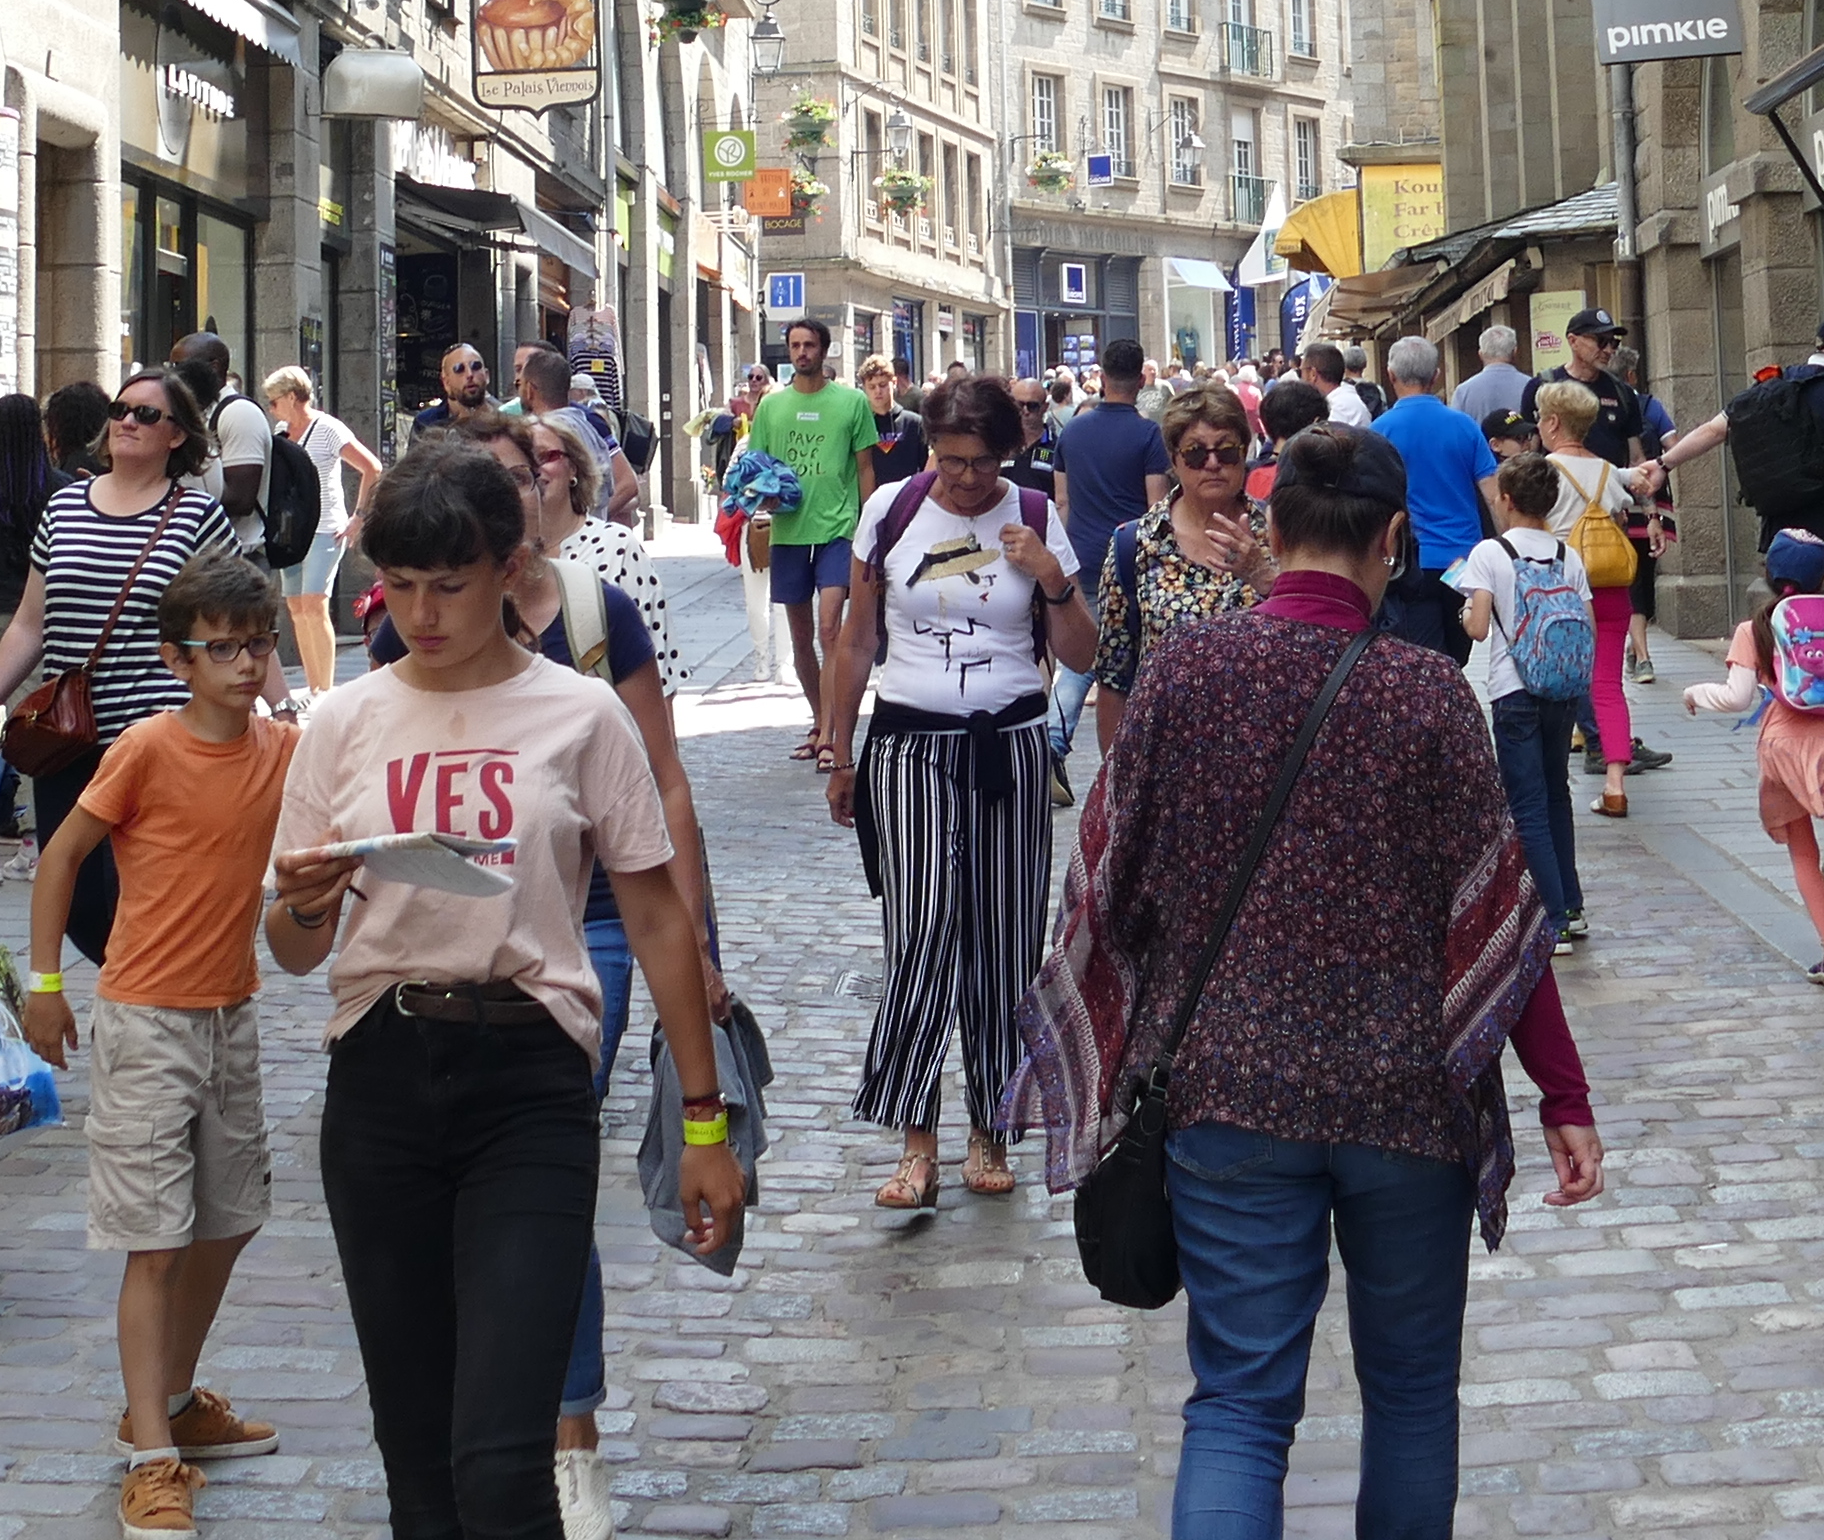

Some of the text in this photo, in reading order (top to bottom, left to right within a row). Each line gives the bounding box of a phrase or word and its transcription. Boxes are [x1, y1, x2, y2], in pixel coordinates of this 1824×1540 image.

[1607, 17, 1728, 55] pimkie
[169, 63, 235, 118] LATITUDE
[480, 76, 595, 98] Le Palais Viennois
[1393, 179, 1443, 194] Kou
[1393, 202, 1430, 217] Far
[764, 218, 802, 229] BOCAGE
